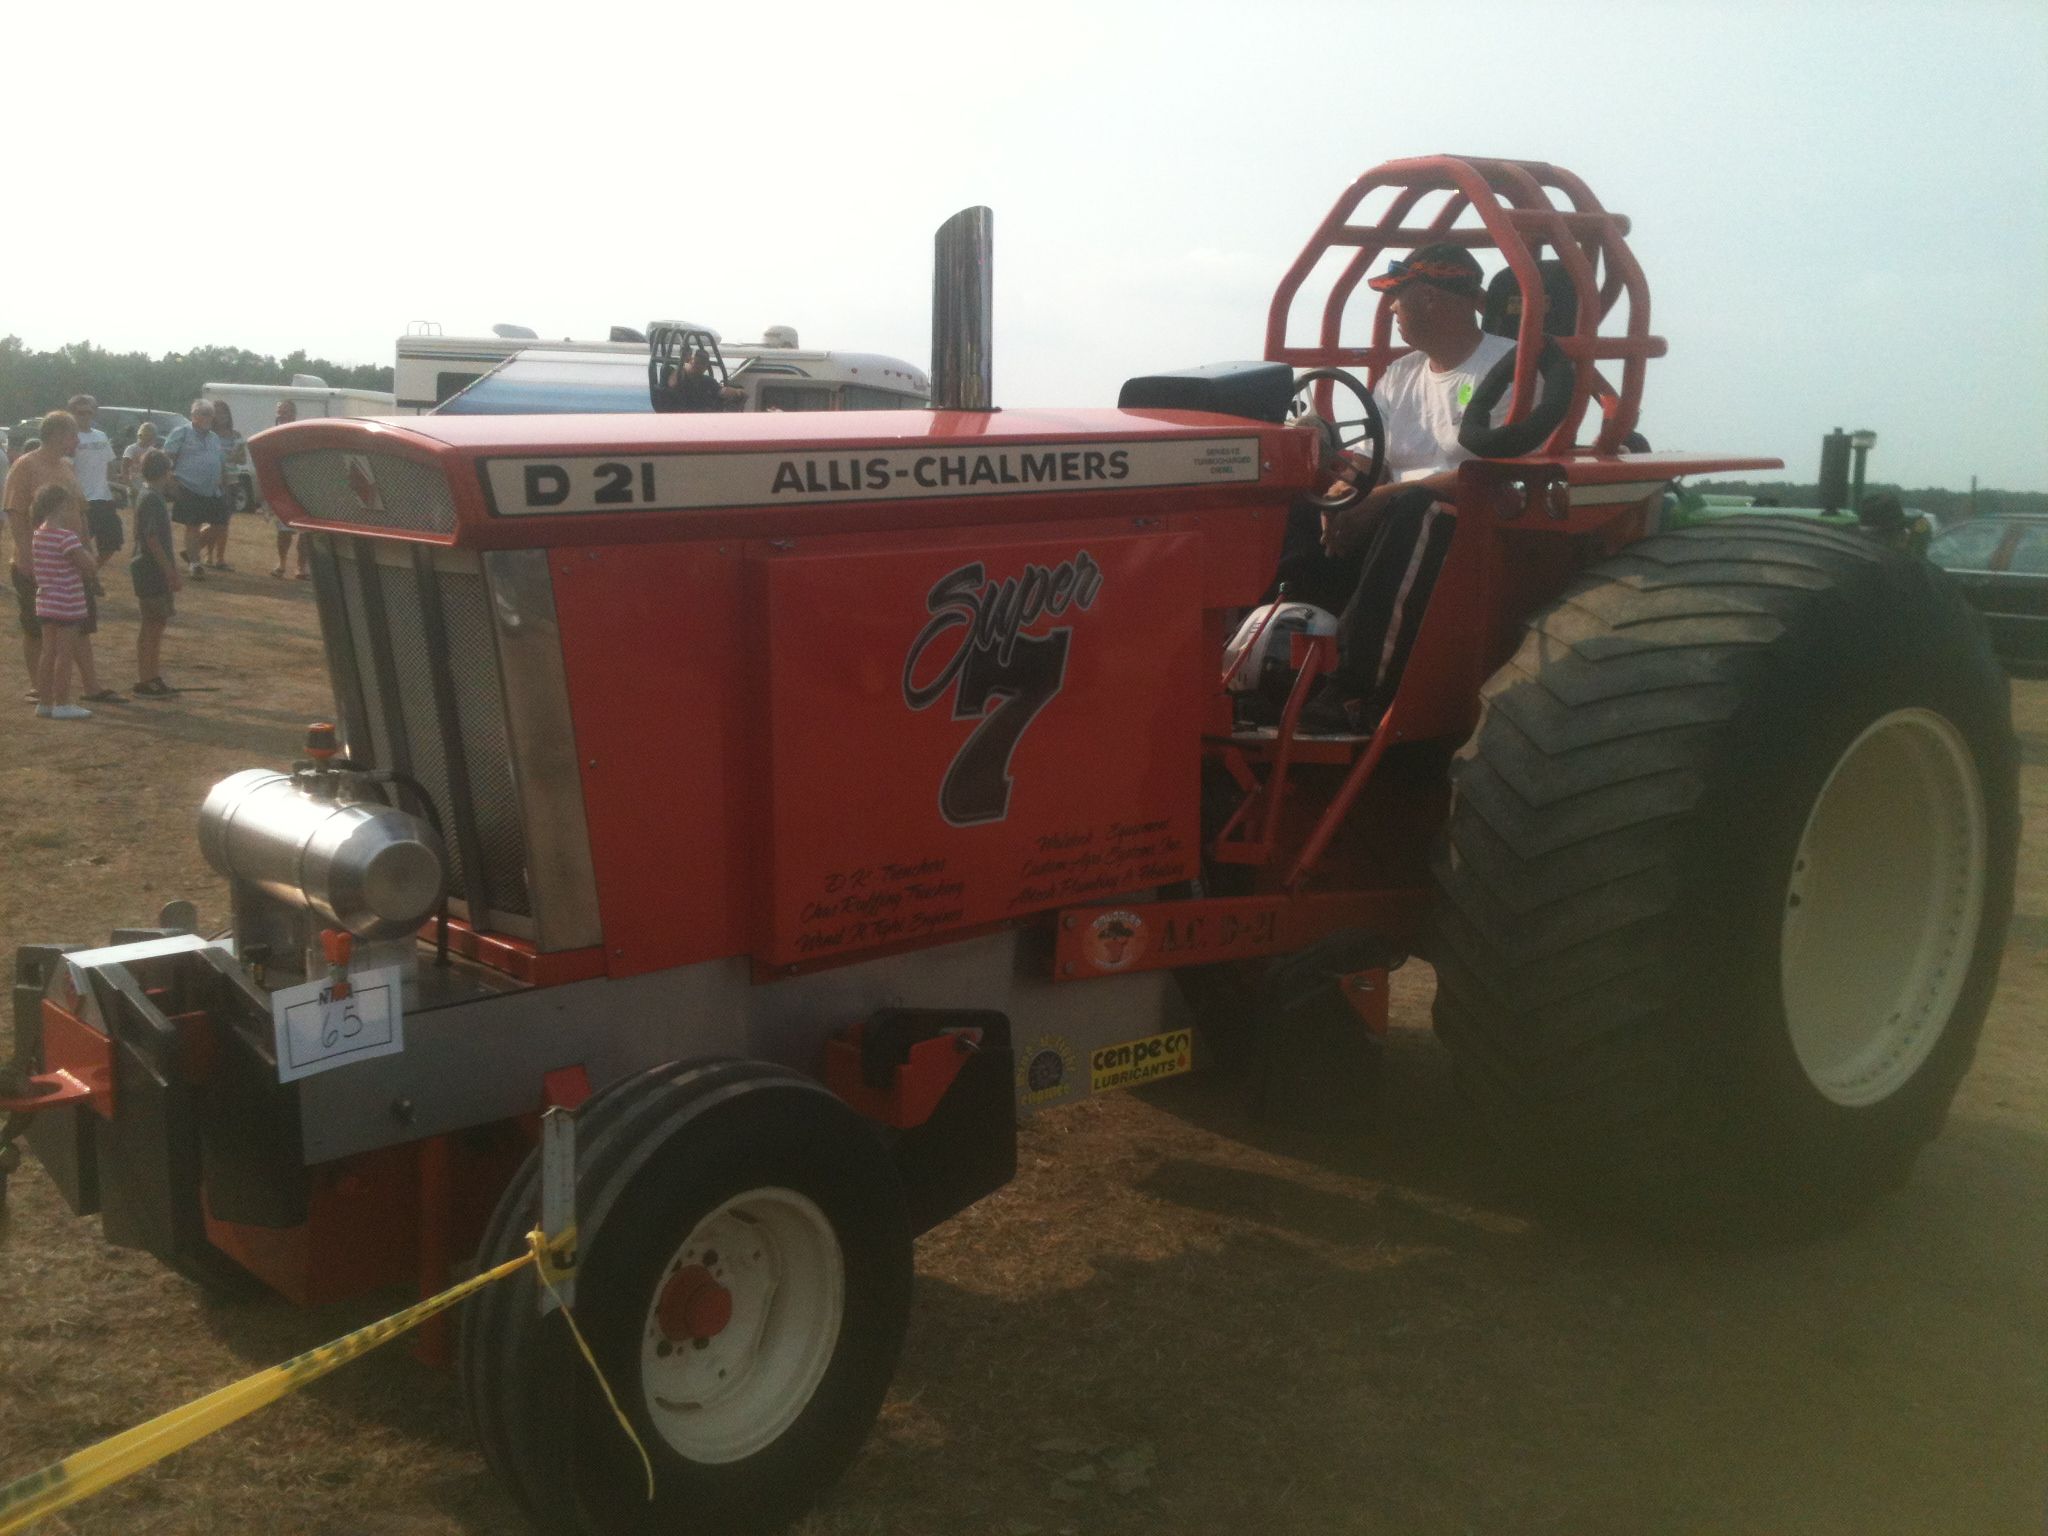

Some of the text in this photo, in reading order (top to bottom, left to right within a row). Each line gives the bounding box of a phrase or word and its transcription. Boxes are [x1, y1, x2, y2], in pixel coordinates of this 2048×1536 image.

[525, 462, 656, 507] D 21
[771, 451, 1130, 494] ALLIS-CHALMERS
[902, 549, 1104, 711] Super
[938, 626, 1073, 827] 7
[322, 1005, 364, 1048] 65
[1094, 1060, 1176, 1090] LUBRICANTS
